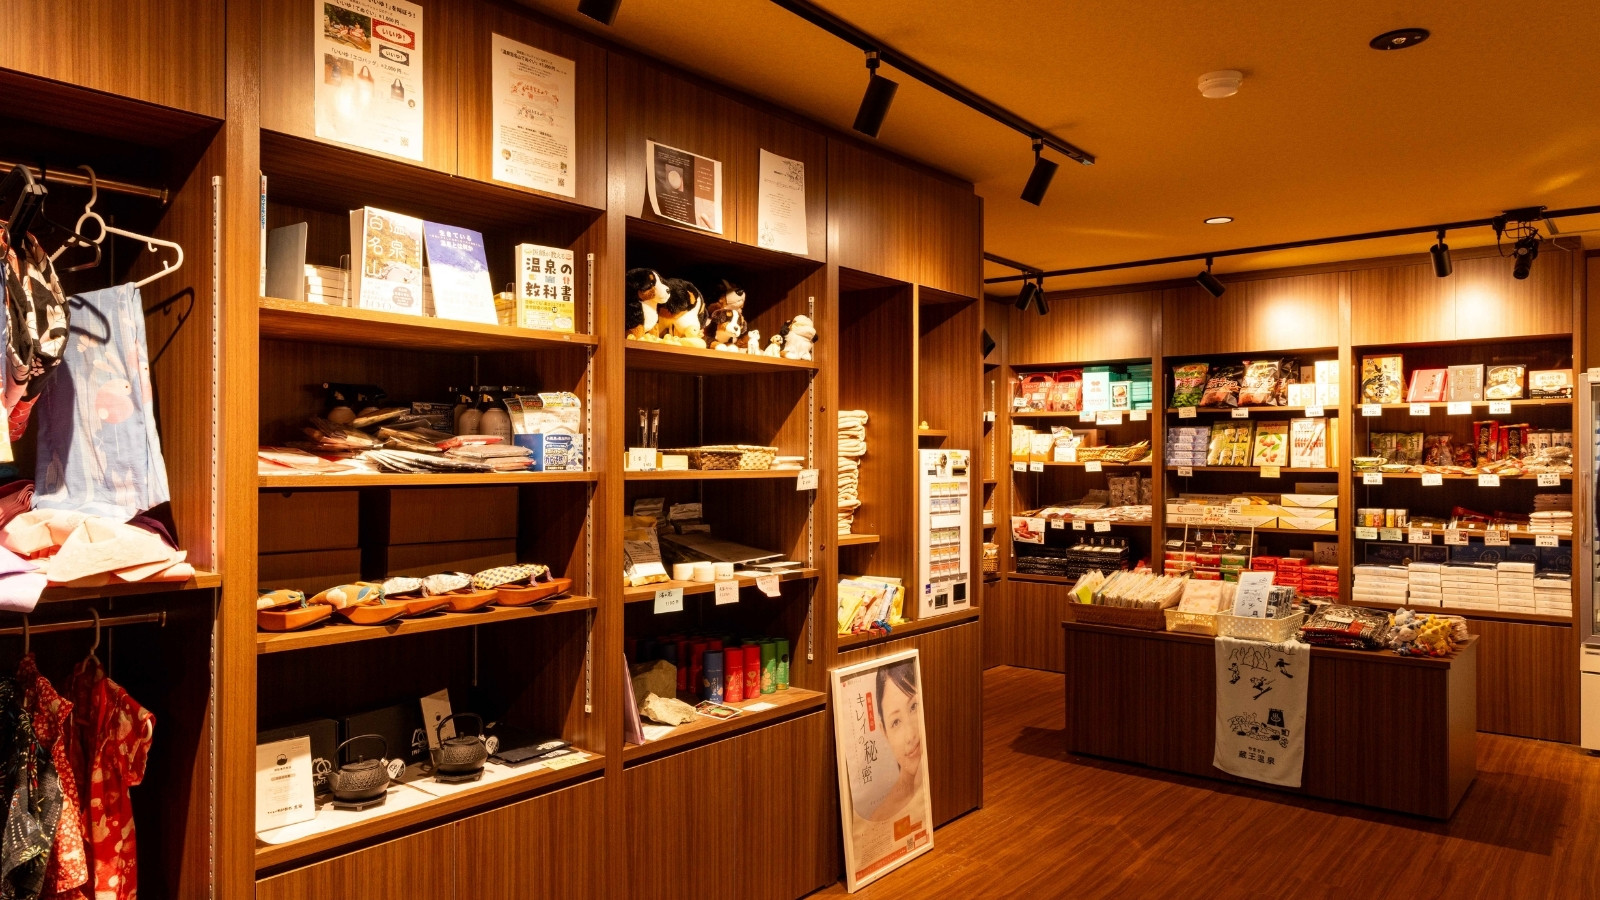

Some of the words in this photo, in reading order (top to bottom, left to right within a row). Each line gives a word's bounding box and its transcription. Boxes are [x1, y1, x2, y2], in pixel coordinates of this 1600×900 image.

[367, 212, 384, 277] 百名山
[526, 258, 572, 275] 温泉の
[526, 281, 572, 302] 教科書
[1238, 750, 1276, 766] 蔵王温泉
